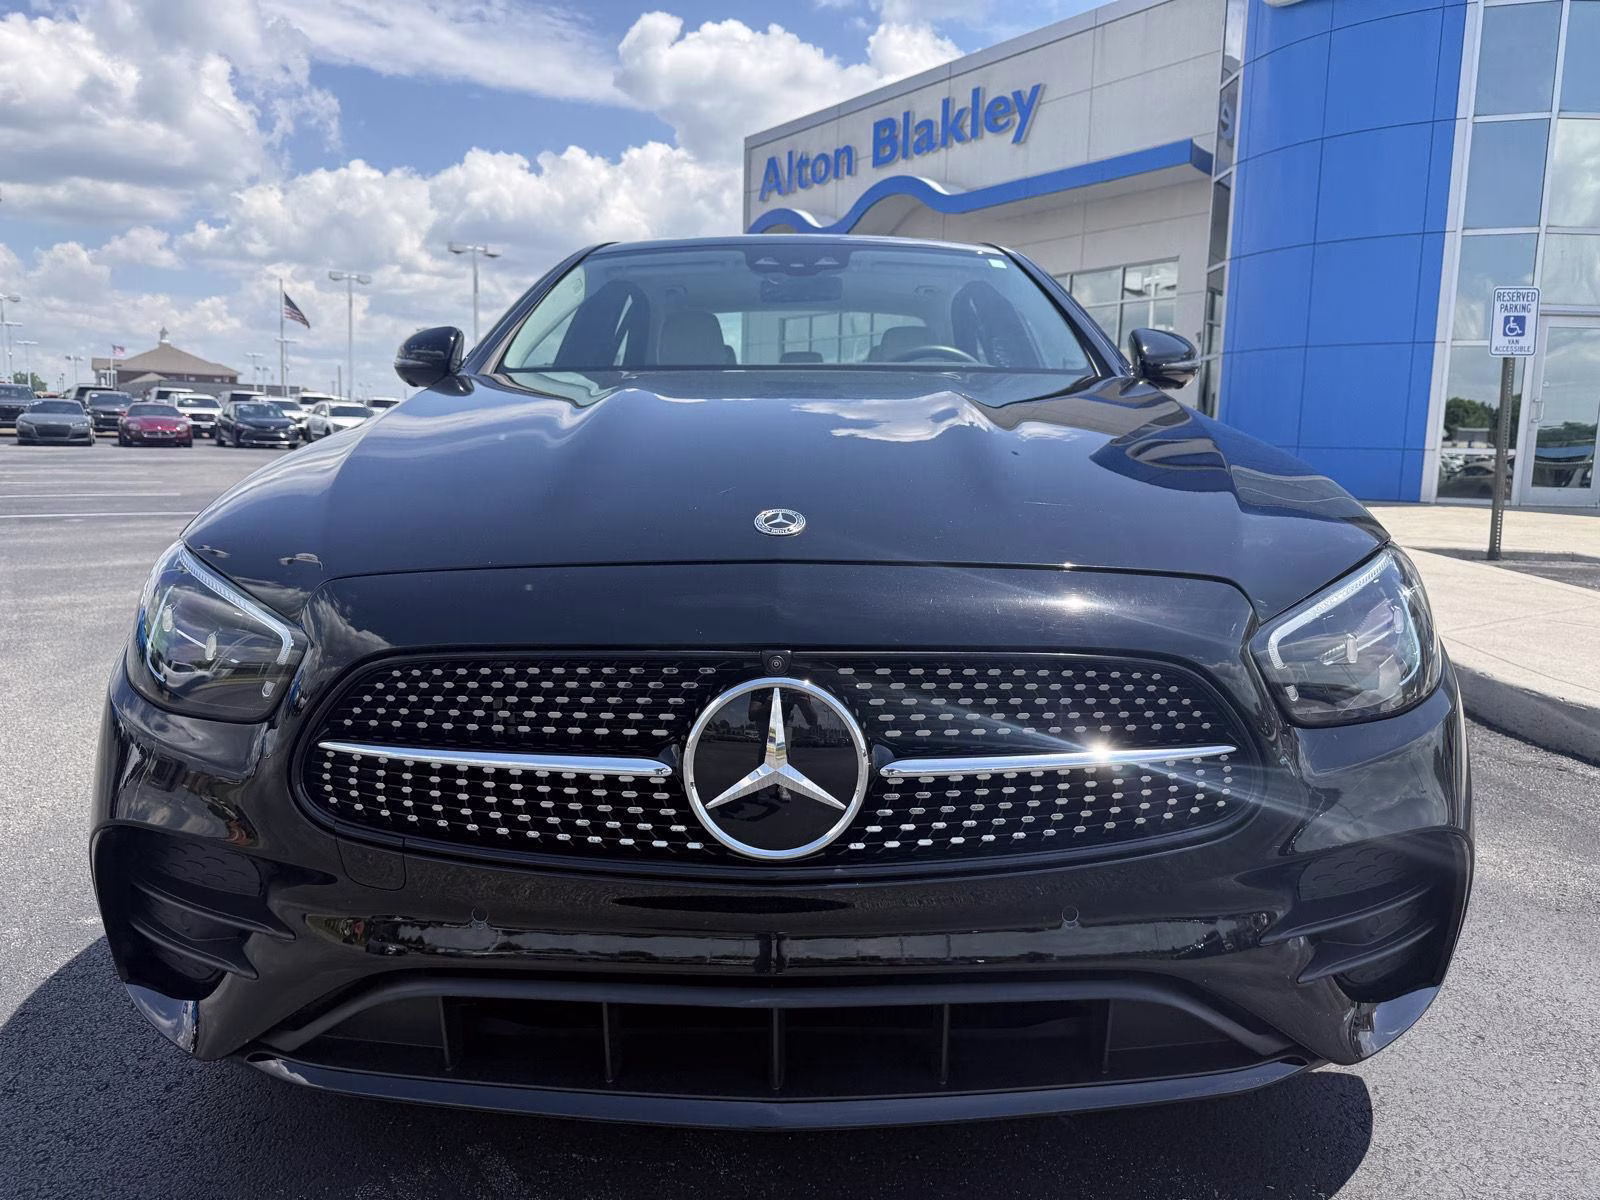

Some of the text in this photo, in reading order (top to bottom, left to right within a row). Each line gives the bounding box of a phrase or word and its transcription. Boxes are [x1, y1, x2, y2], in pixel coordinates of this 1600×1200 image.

[759, 83, 1046, 202] Alton Blakley
[1496, 291, 1536, 302] RESERVED
[1500, 304, 1531, 313] PARKING
